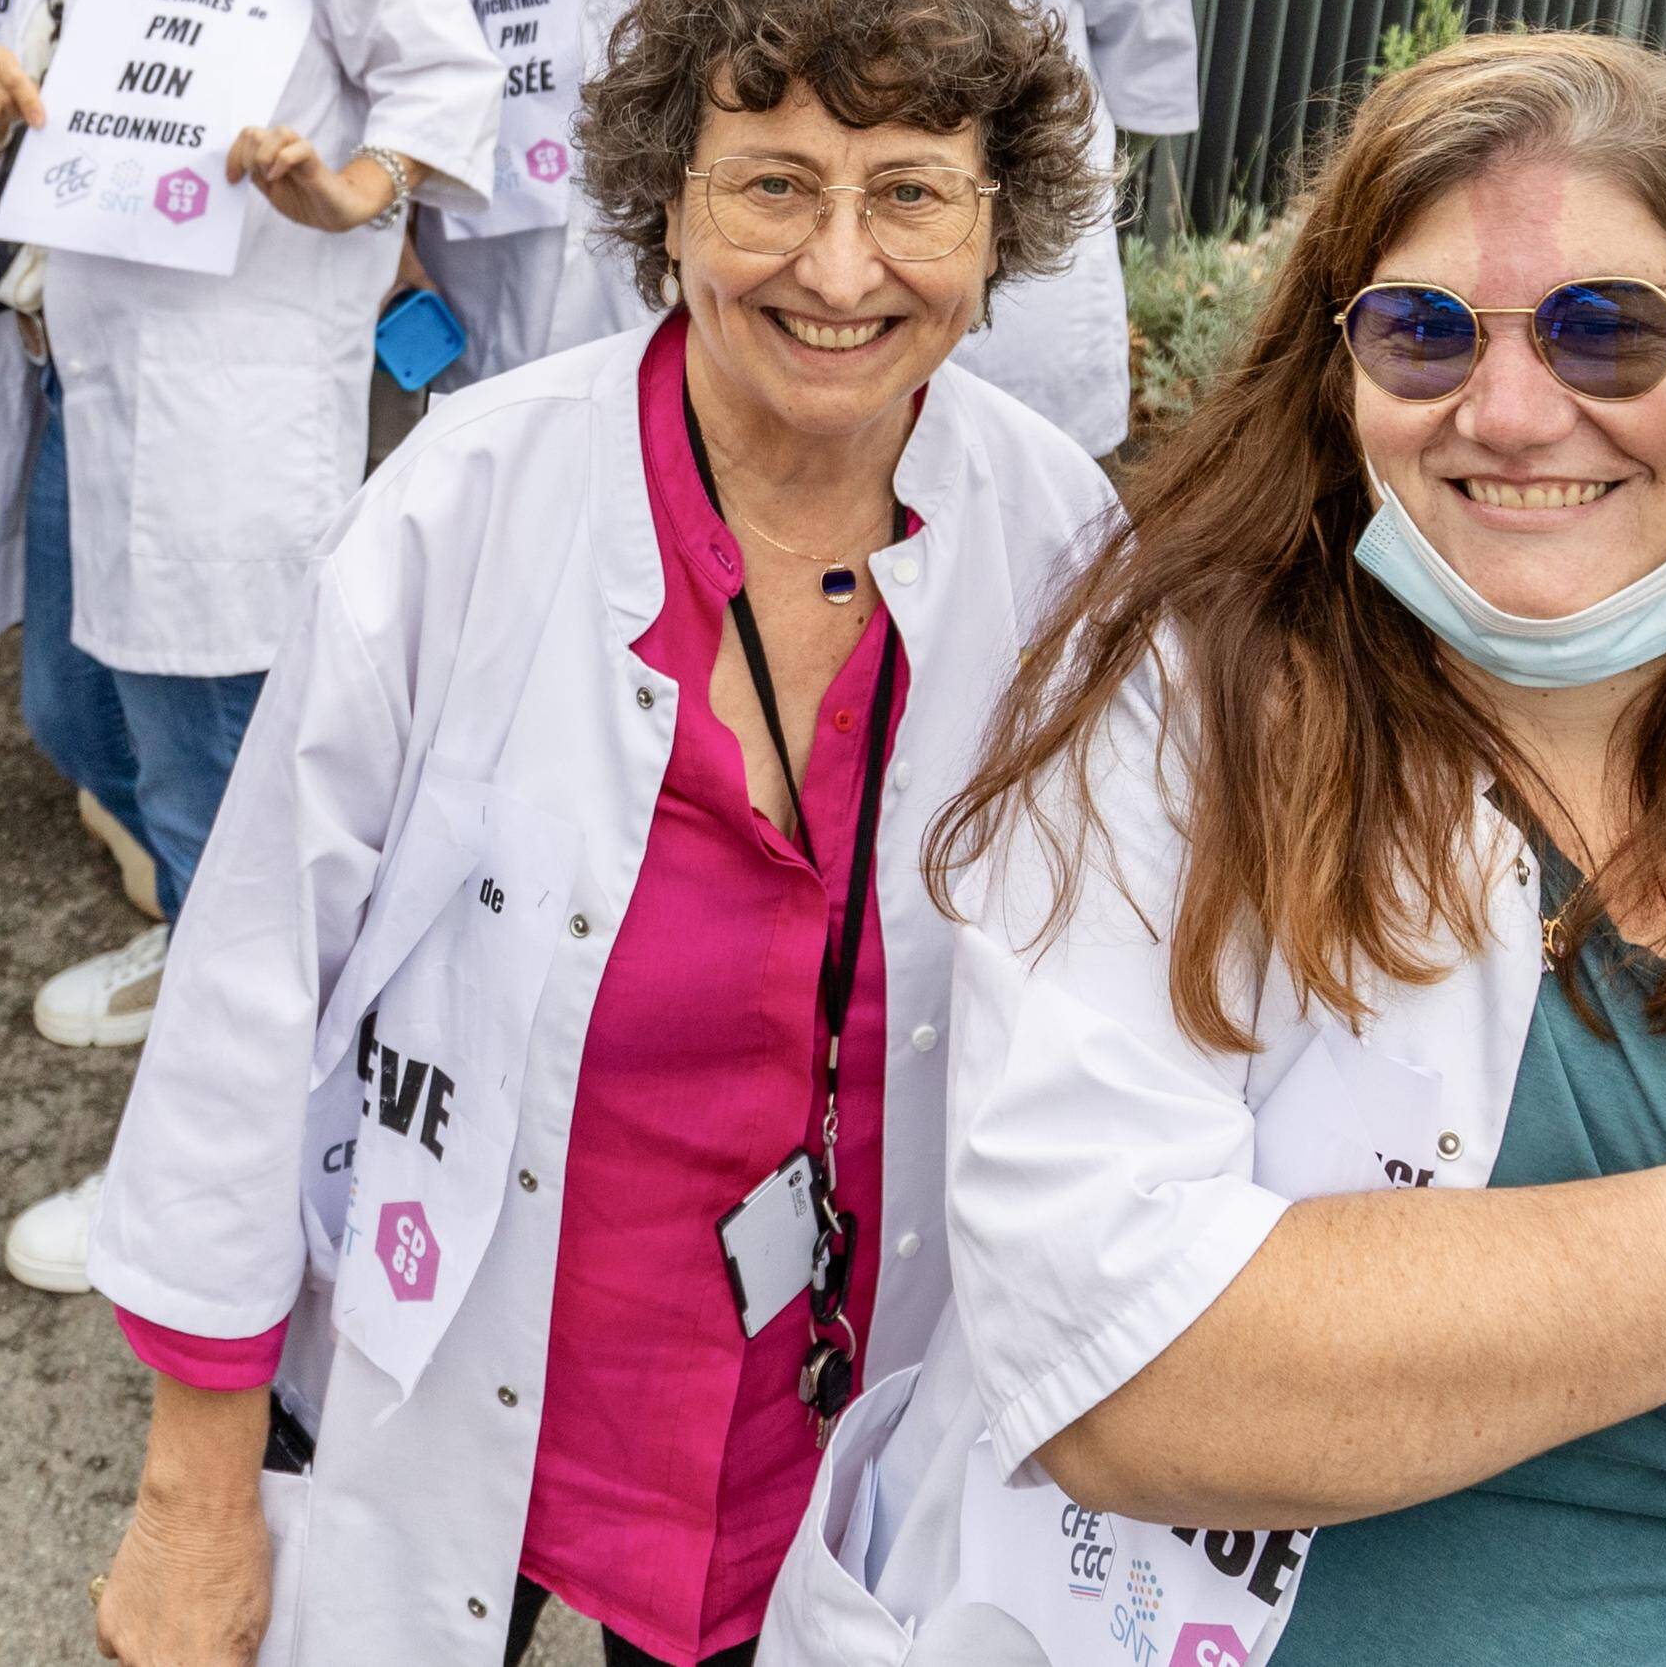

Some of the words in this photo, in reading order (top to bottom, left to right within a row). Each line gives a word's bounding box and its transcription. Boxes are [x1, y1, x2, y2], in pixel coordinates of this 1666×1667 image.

[144, 14, 204, 47] PMI
[248, 6, 268, 20] de
[499, 21, 539, 49] PMI
[117, 60, 193, 99] NON
[67, 110, 206, 149] RECONNUES
[43, 155, 81, 188] CFE
[167, 177, 197, 197] CD
[166, 193, 191, 214] 83
[479, 877, 505, 915] de
[396, 1216, 427, 1259] CD
[392, 1244, 418, 1286] 83
[1061, 1502, 1106, 1540] CFE
[1070, 1543, 1113, 1582] CGC
[1110, 1604, 1159, 1667] SNT
